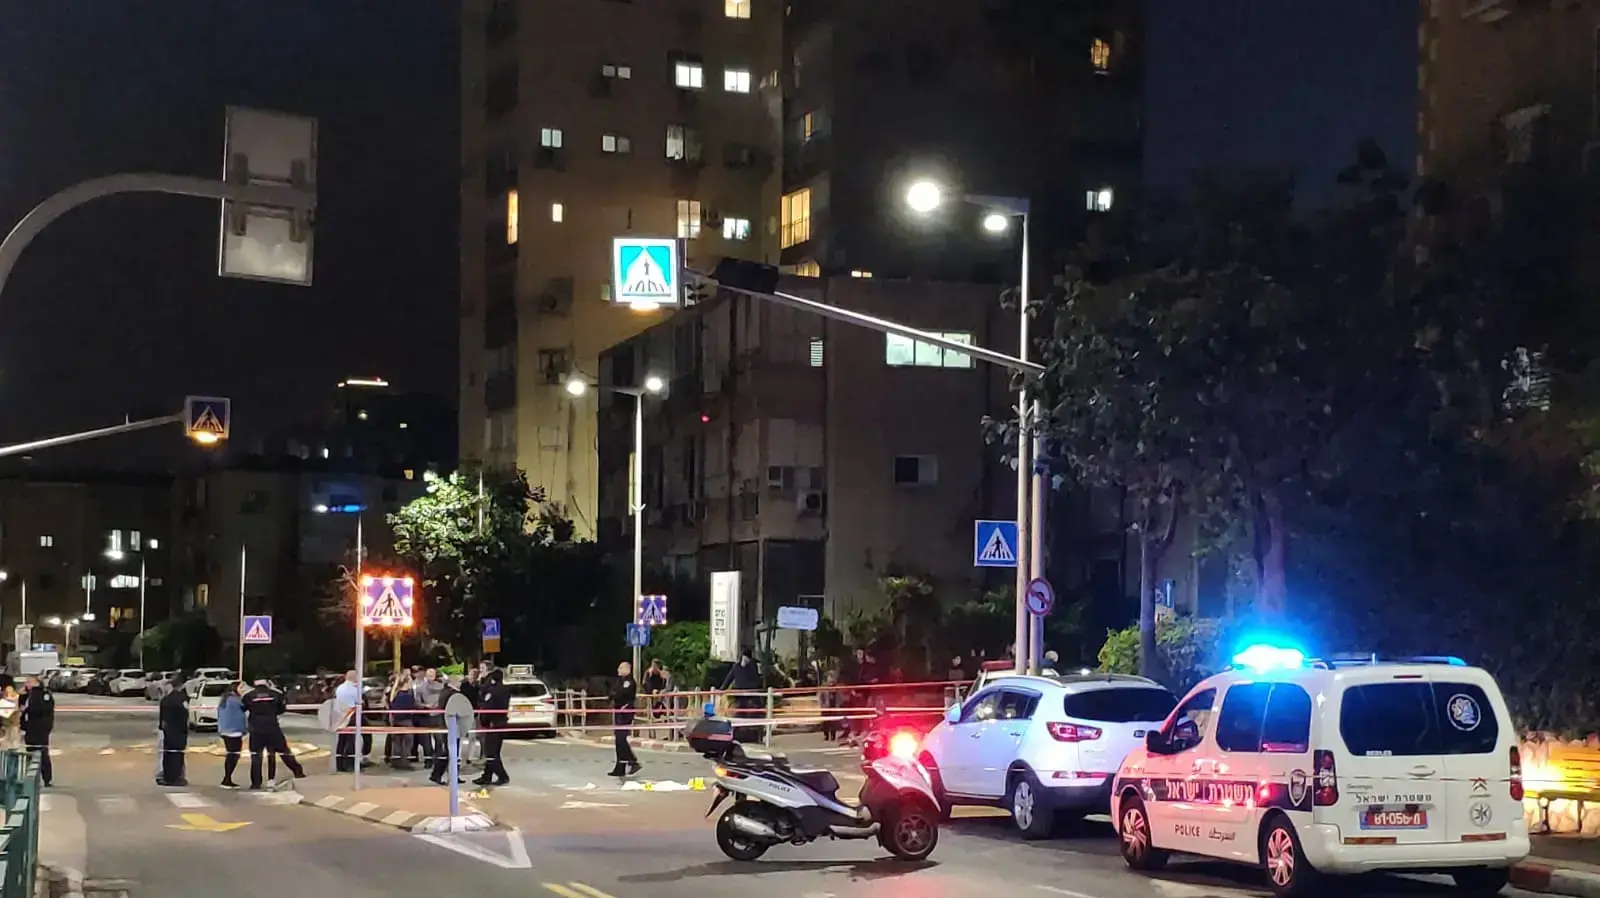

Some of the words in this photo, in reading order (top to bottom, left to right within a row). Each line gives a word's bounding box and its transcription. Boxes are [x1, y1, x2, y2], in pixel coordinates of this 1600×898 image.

[1165, 777, 1200, 801] ישראל
[1209, 783, 1254, 804] משטרת
[1356, 793, 1389, 803] ישראל
[1394, 793, 1433, 802] משטרת
[1175, 824, 1201, 837] POLICE
